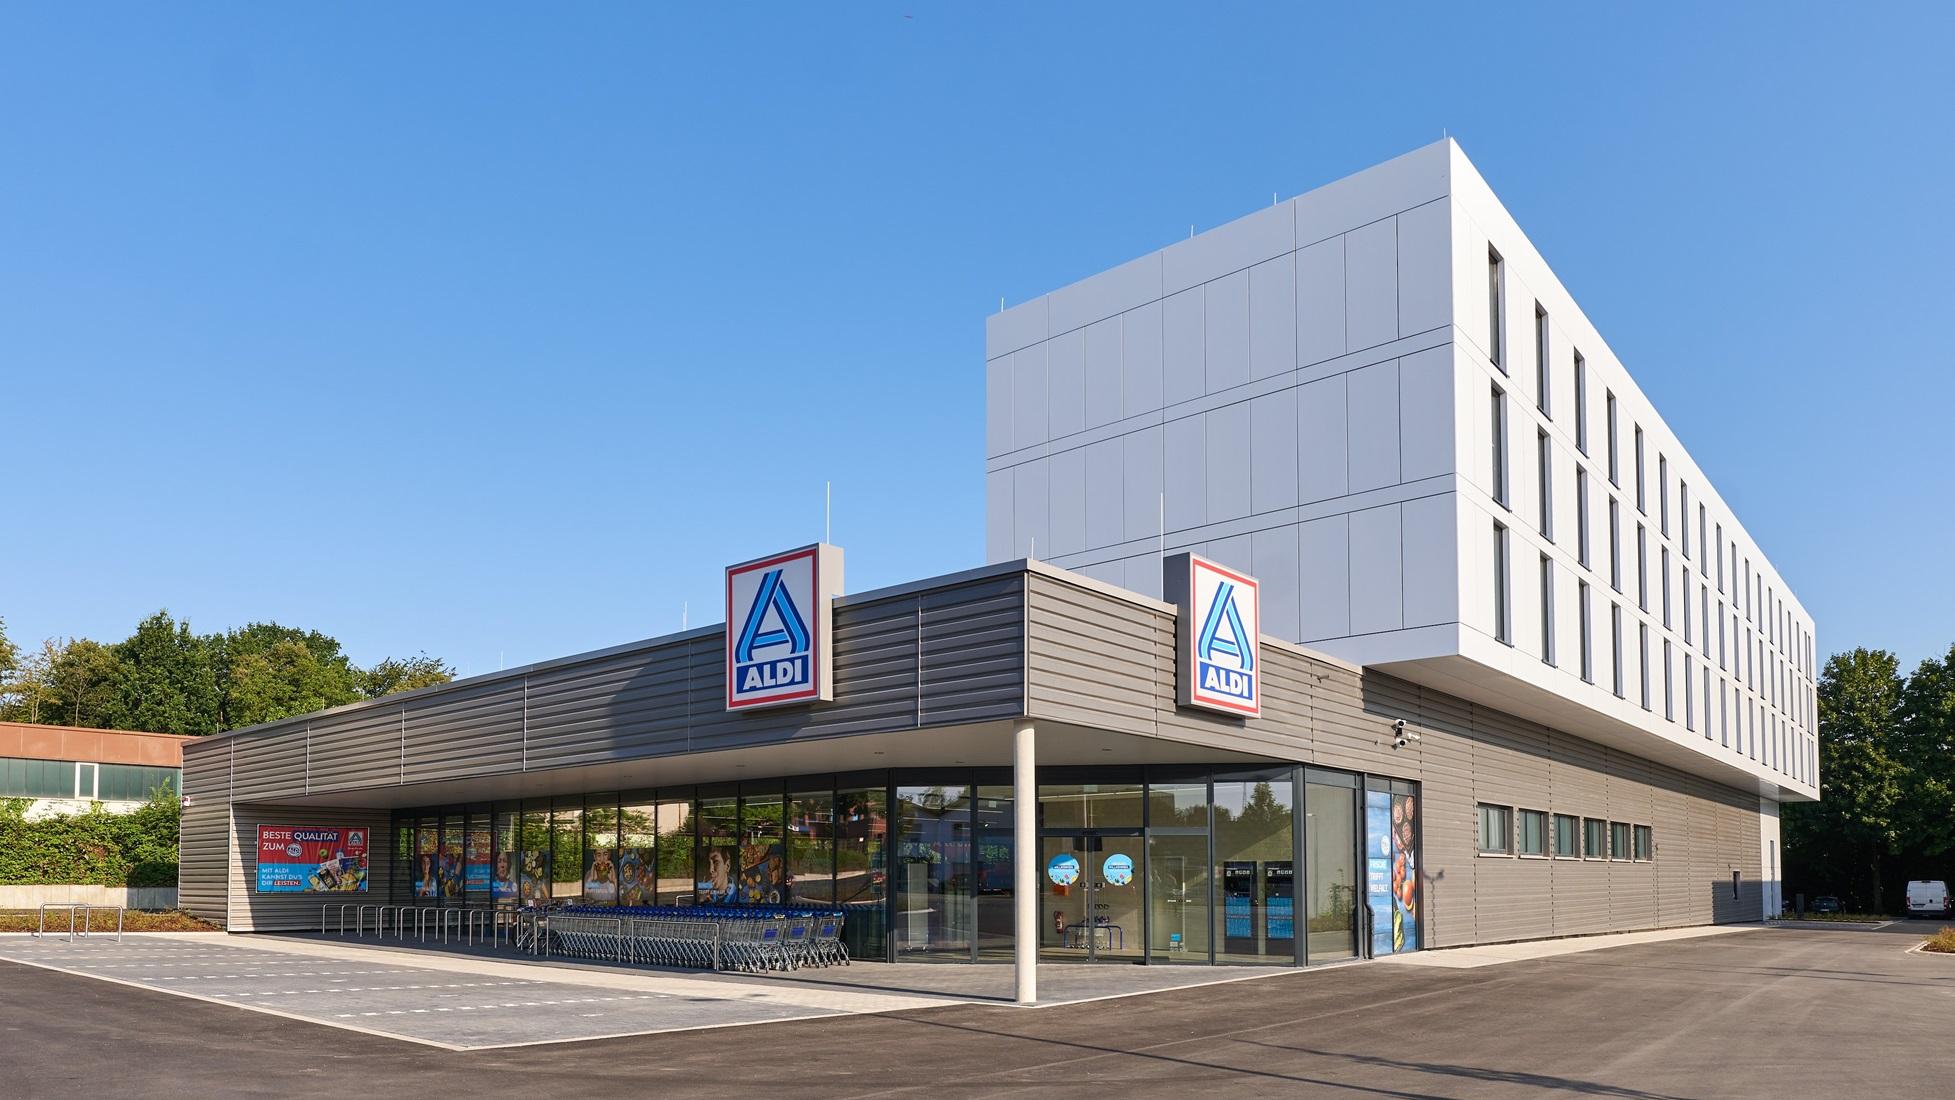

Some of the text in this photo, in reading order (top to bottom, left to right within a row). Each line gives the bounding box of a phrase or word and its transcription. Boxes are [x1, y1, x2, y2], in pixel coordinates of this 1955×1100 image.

[743, 659, 802, 690] ALDI
[1204, 666, 1249, 698] ALDI
[263, 831, 338, 841] BESTE QUALITÄT
[263, 842, 285, 850] ZUM
